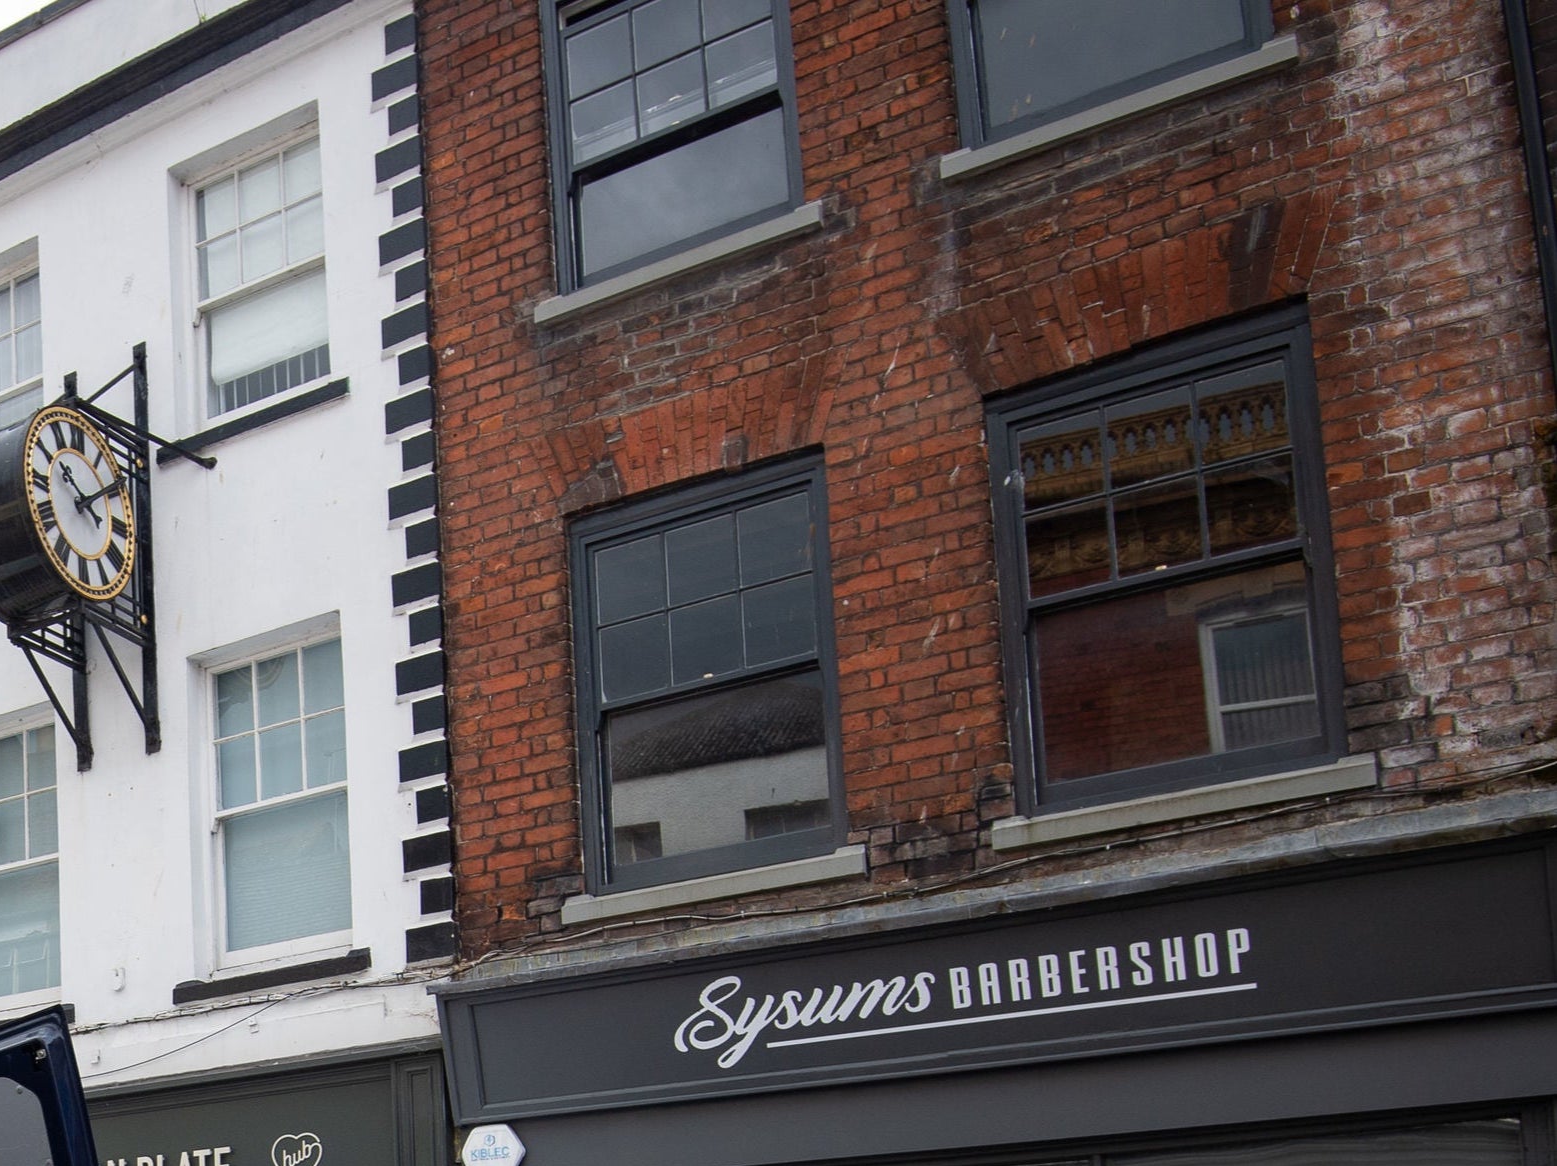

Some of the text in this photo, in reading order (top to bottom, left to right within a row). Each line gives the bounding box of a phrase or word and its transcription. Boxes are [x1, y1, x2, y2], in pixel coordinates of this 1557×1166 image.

[674, 928, 1251, 1069] Sysums BARBERSHOP
[470, 1146, 510, 1159] KIBLEC
